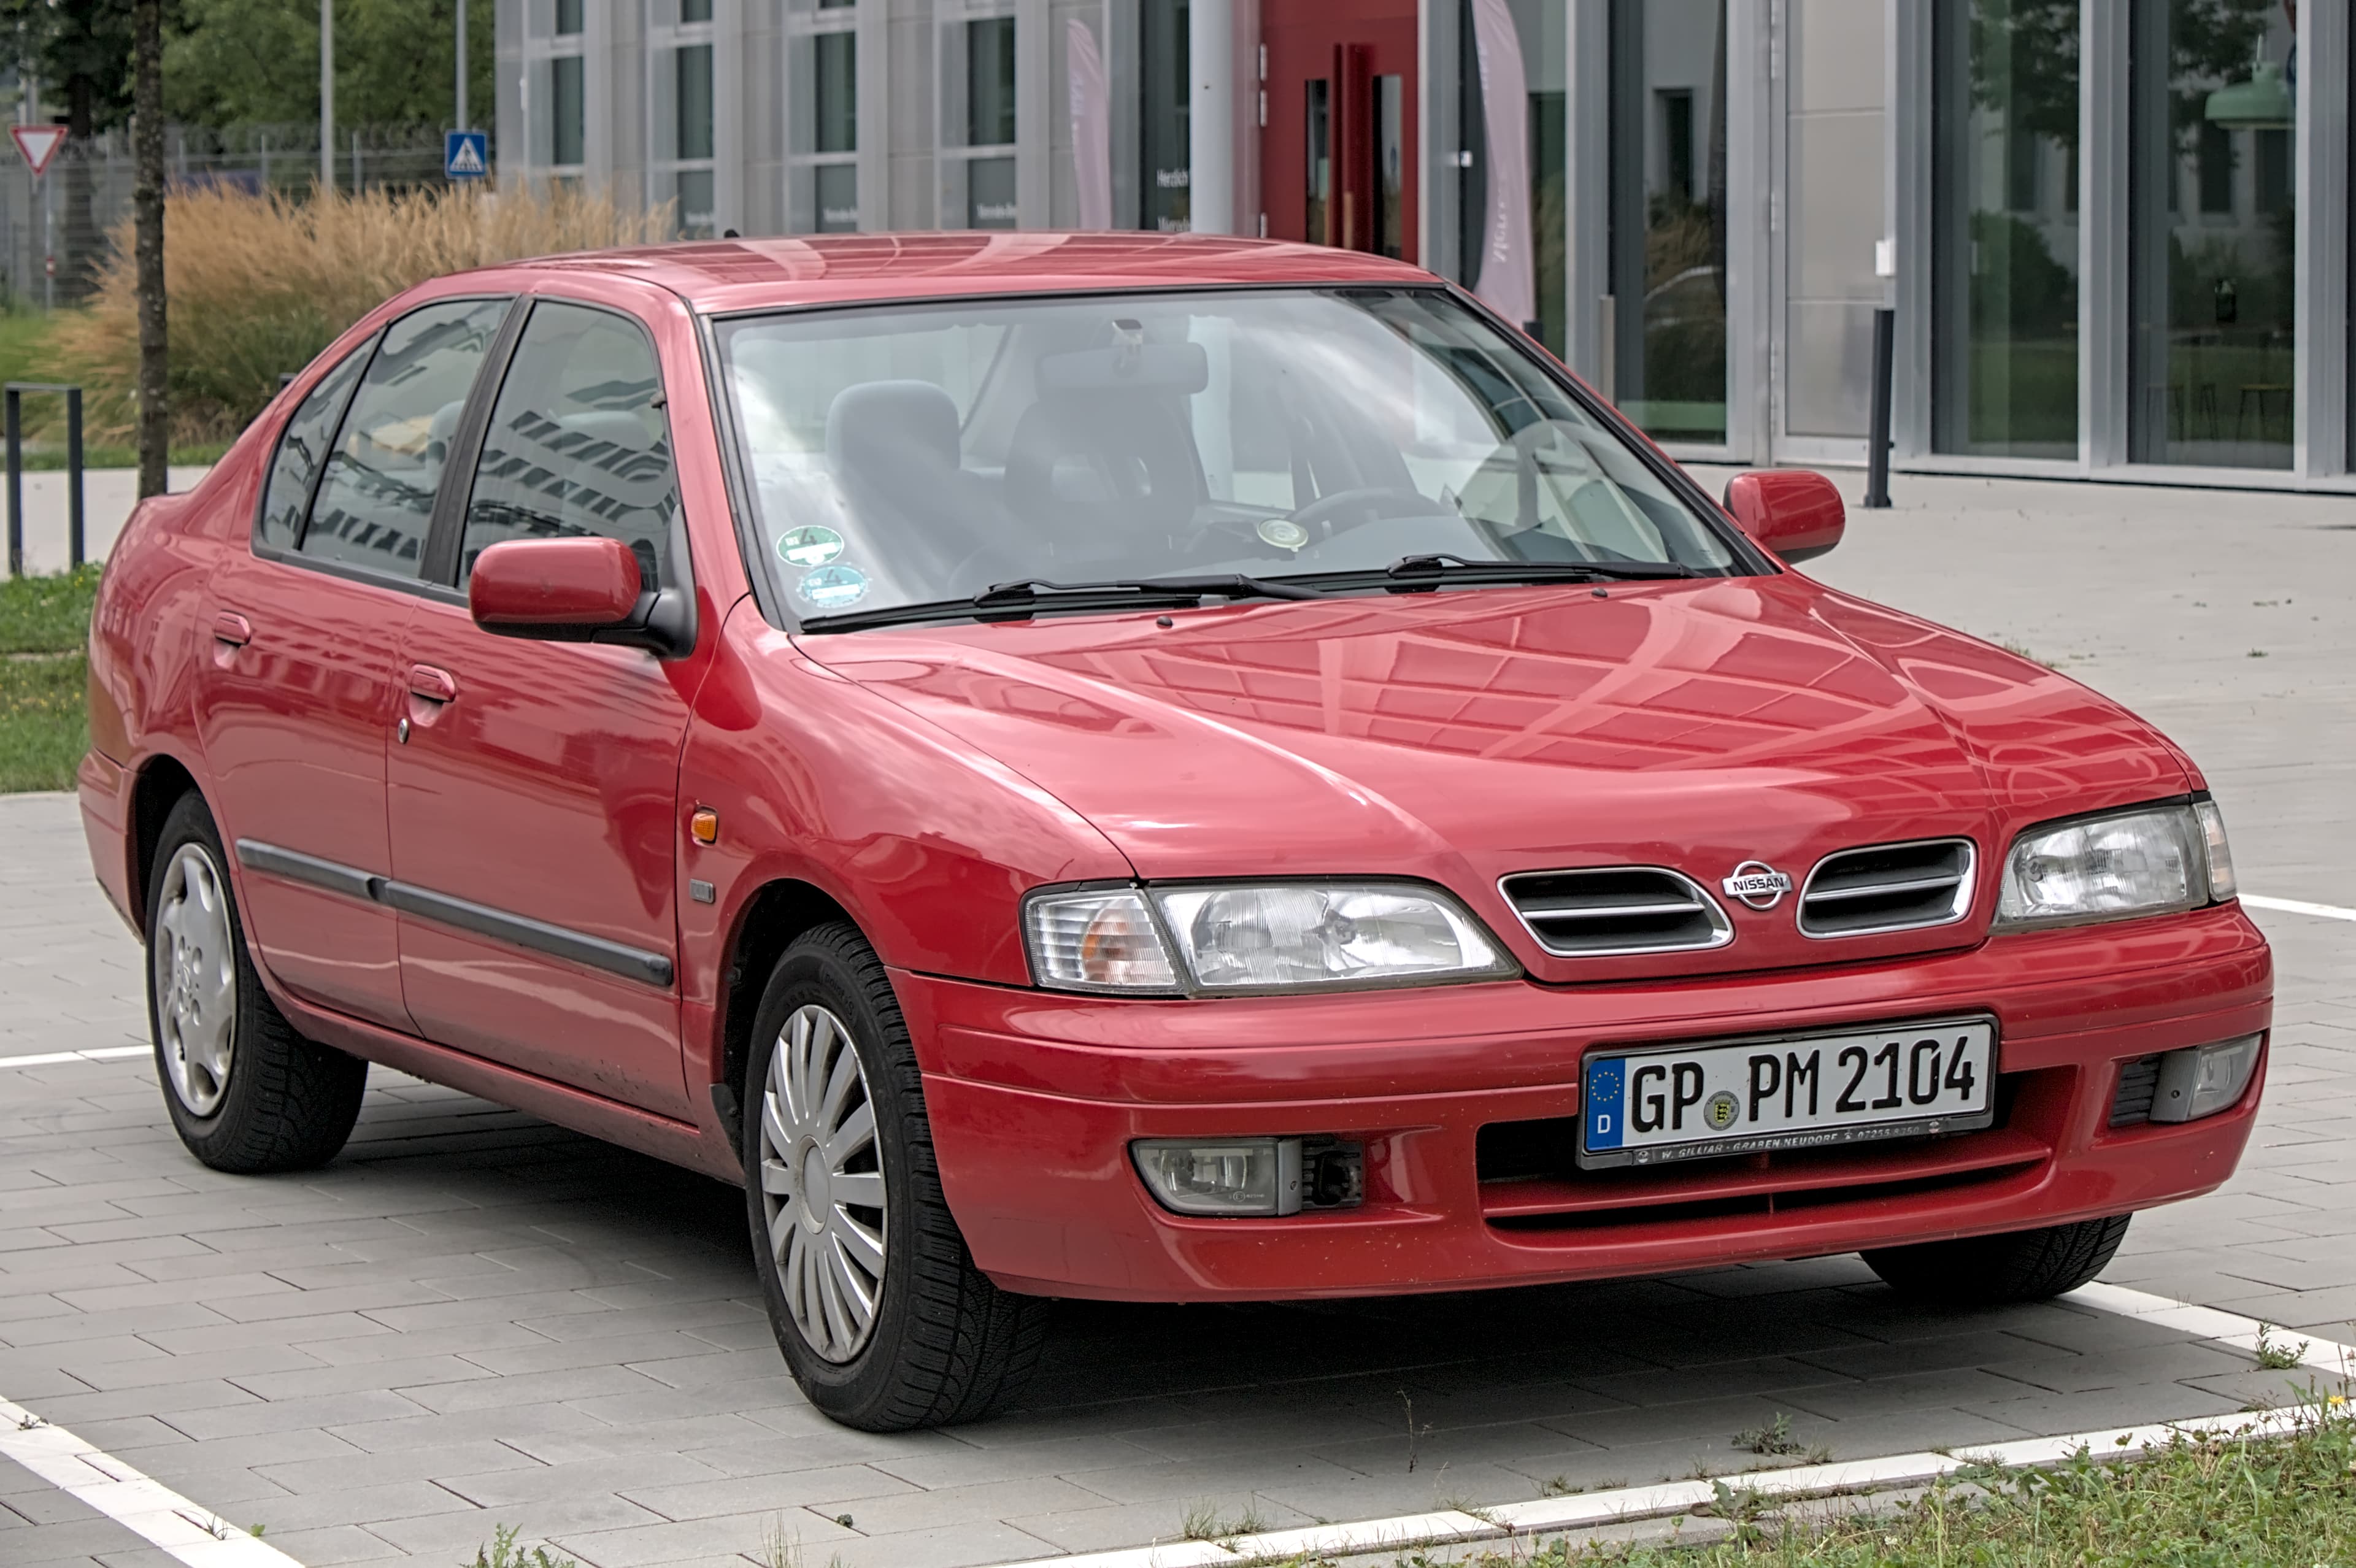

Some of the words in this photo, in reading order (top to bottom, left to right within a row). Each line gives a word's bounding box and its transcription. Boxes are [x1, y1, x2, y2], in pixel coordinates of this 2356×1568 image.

[800, 528, 817, 545] 4
[825, 569, 842, 584] 4
[1732, 877, 1785, 891] NISSAN
[1631, 1061, 1704, 1133] GP
[1748, 1048, 1820, 1121] PM
[1835, 1036, 1975, 1113] 2104
[1597, 1114, 1611, 1134] D
